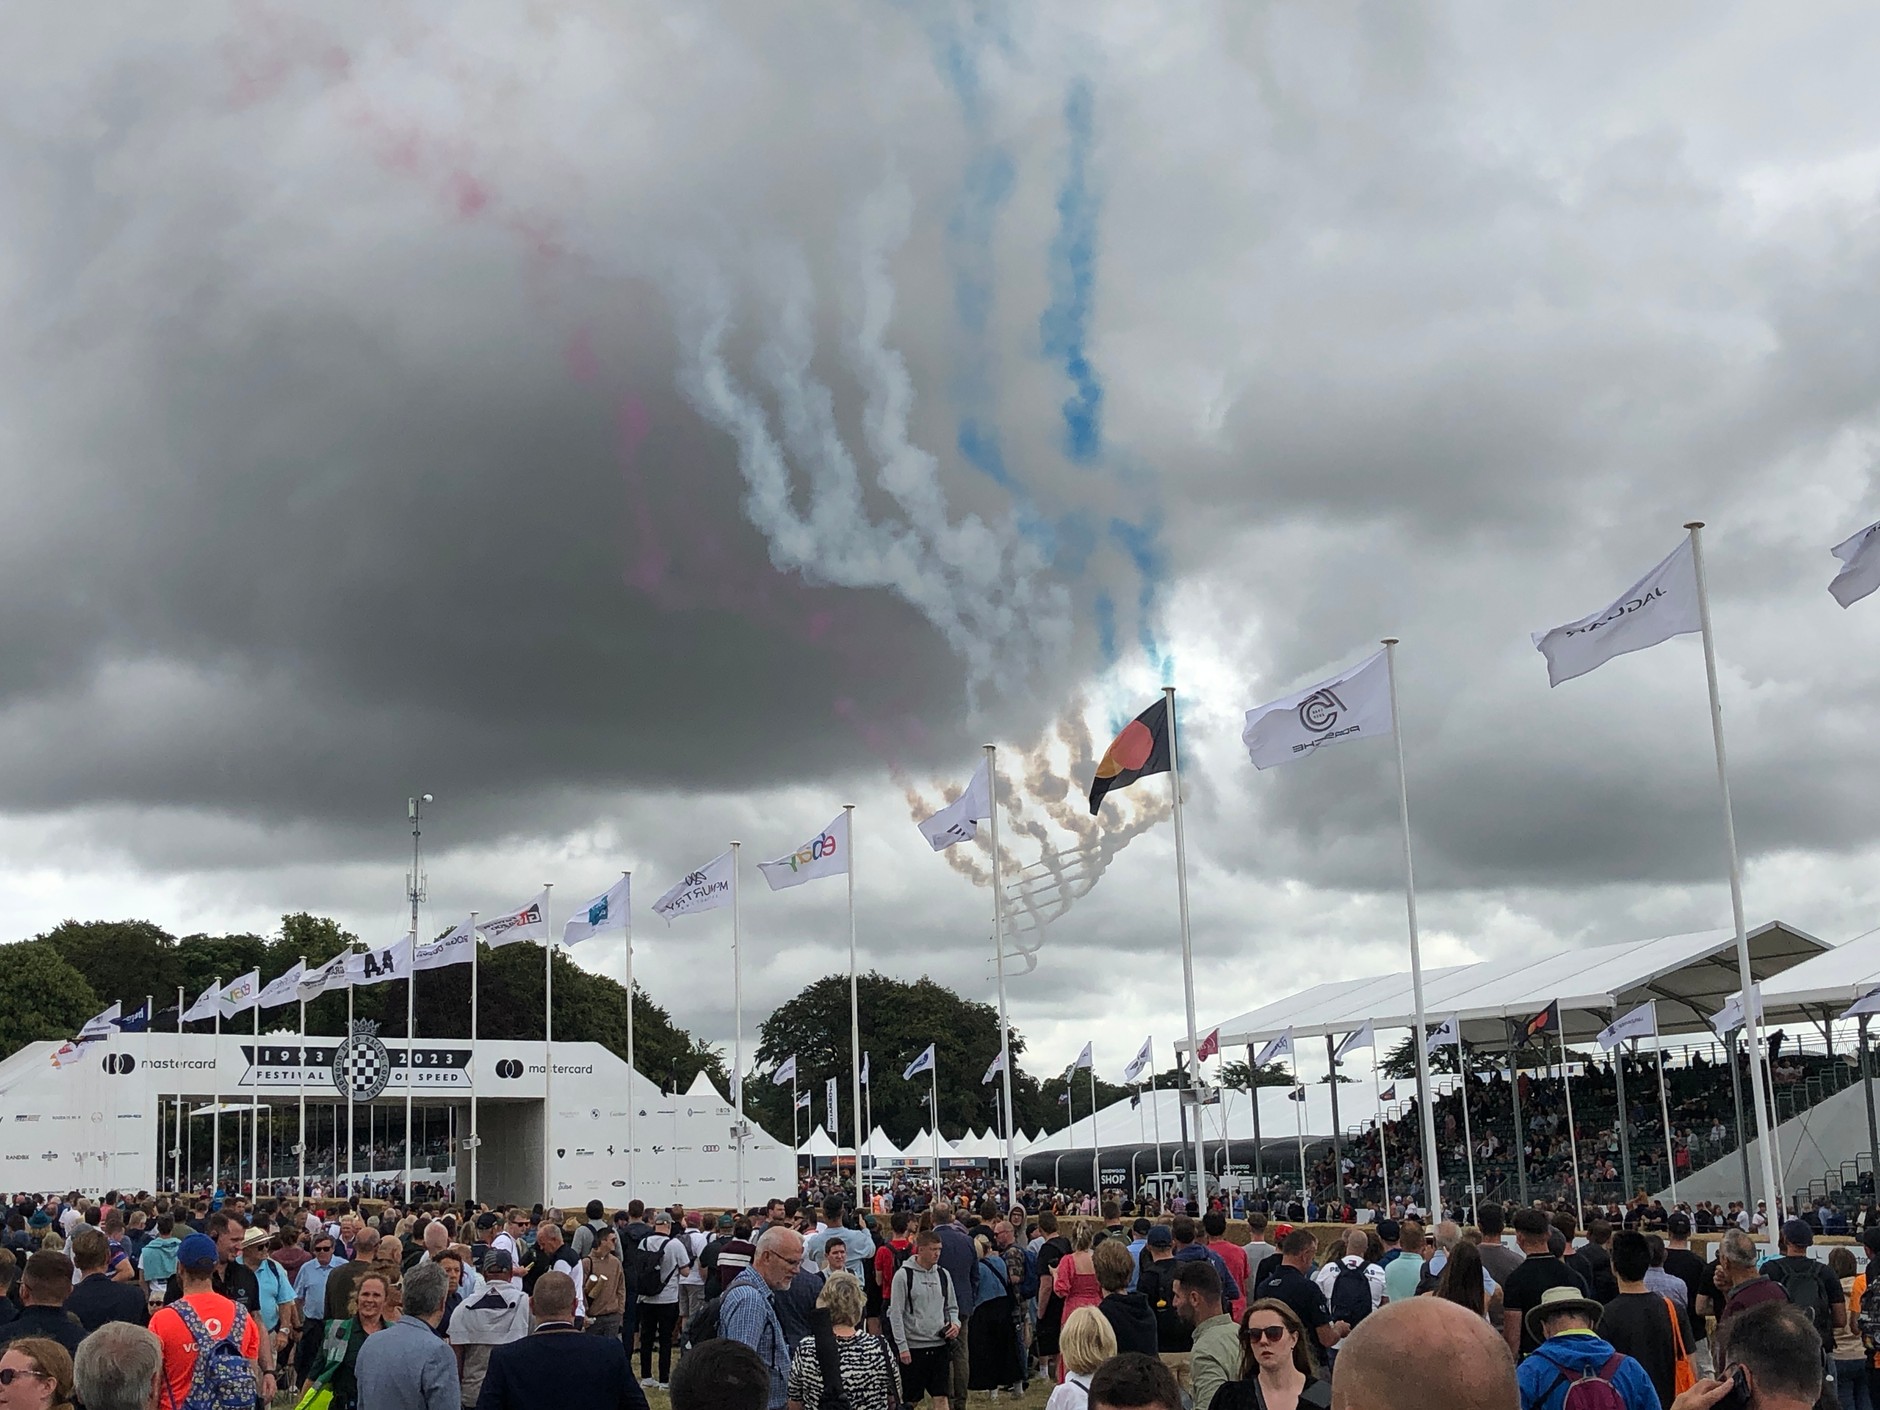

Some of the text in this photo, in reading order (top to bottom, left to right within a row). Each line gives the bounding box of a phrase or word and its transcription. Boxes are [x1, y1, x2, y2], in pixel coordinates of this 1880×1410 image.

[365, 1036, 387, 1061] RACING
[264, 1050, 453, 1065] 1993 2023
[141, 1058, 216, 1070] mastercard
[529, 1064, 593, 1074] matercard
[257, 1071, 324, 1080] FESTIVAL
[418, 1073, 458, 1082] SPEED
[366, 1064, 388, 1098] COMPANY
[1101, 1174, 1126, 1185] SHOP
